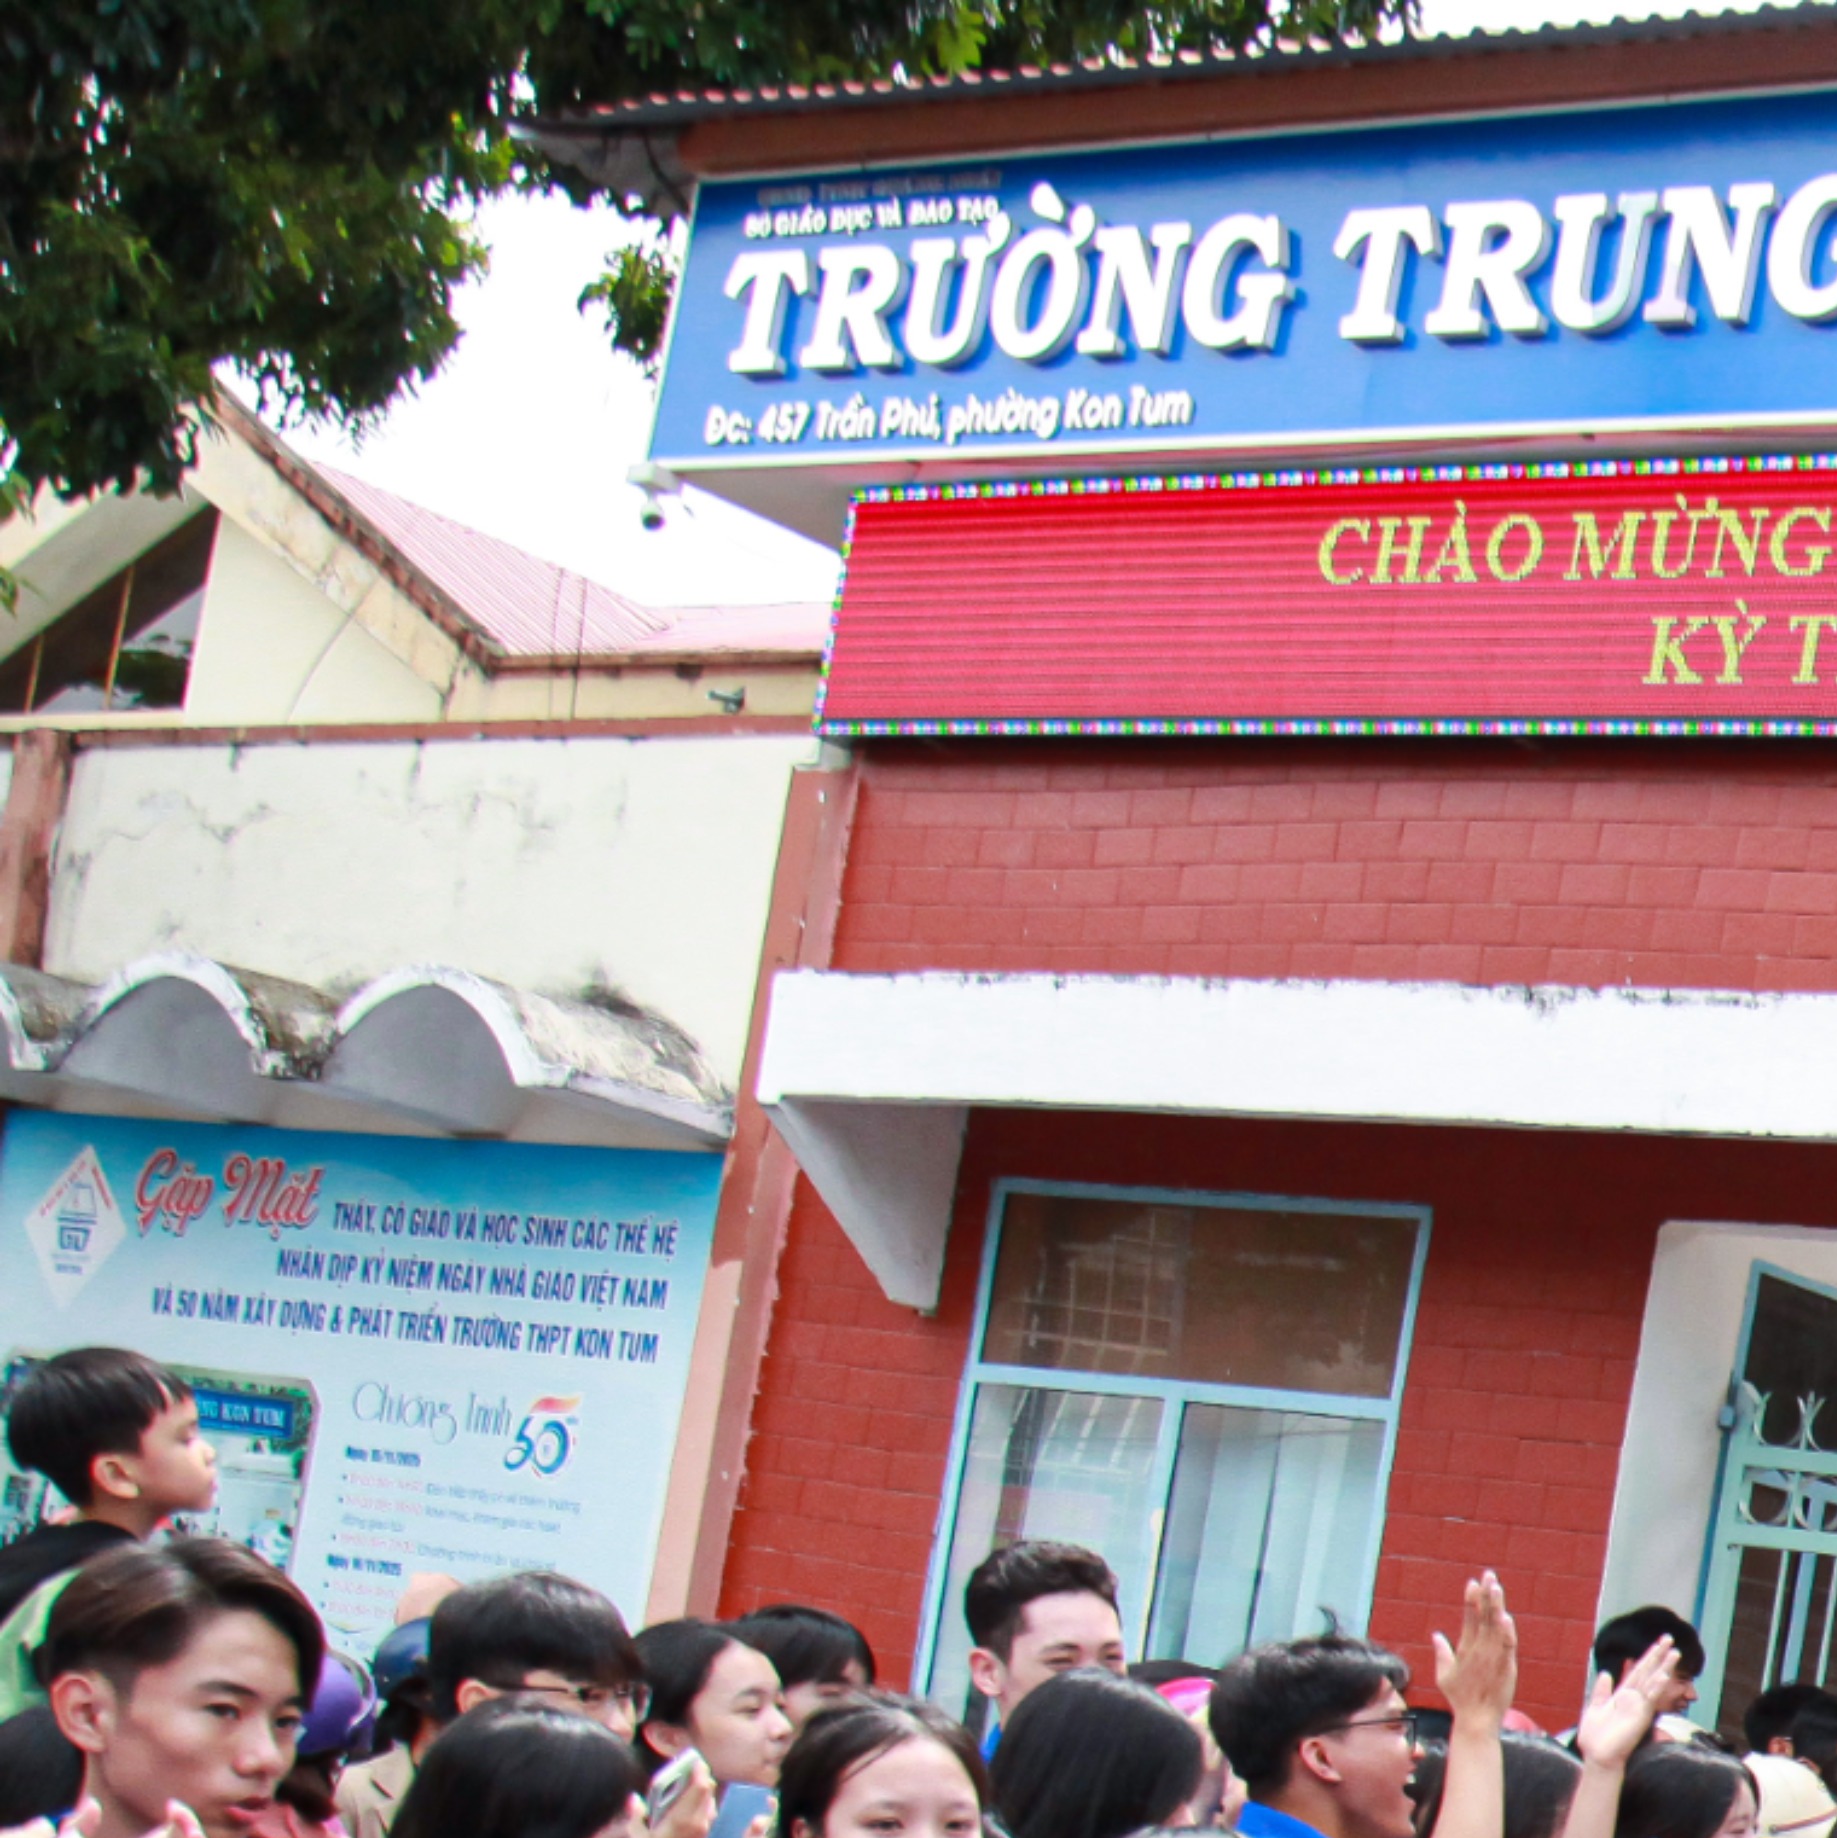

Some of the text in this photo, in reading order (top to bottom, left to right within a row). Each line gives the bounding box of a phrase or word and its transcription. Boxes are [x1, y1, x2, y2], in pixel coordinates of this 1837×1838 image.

[774, 201, 828, 237] GIÁO
[830, 203, 873, 237] DỤC
[876, 195, 903, 229] VÀ
[957, 195, 999, 227] TẠO
[724, 181, 1294, 375] TRƯỜNG
[705, 384, 1194, 446] Đc: 457 Trần Phú, phường Kon Tum
[1316, 500, 1544, 585] CHÀO
[1563, 493, 1832, 581] MỪNG
[1641, 598, 1763, 684] KỲ
[136, 1148, 214, 1237] Gặp
[223, 1154, 325, 1241] Mặt
[455, 1206, 479, 1241] VÀ
[481, 1212, 519, 1250] HỌC
[523, 1215, 570, 1249] SINH
[571, 1213, 609, 1252] CÁC
[614, 1214, 653, 1255] THẾ
[651, 1219, 680, 1263] HỆ
[327, 1253, 359, 1289] DỊP
[387, 1253, 436, 1295] NIỆM
[489, 1261, 529, 1298] NHÀ
[530, 1265, 577, 1302] GIÁO
[581, 1268, 620, 1312] VIỆT
[622, 1277, 669, 1310] NAM
[175, 1289, 199, 1318] 50
[200, 1287, 241, 1324] NĂM
[278, 1300, 327, 1332] DỰNG
[330, 1304, 345, 1335] &
[347, 1302, 393, 1338] PHÁT
[397, 1301, 448, 1344] TRIỂN
[451, 1312, 523, 1351] TRƯỜNG
[526, 1322, 573, 1357] THPT
[574, 1326, 614, 1360] KON
[618, 1330, 660, 1364] TUM
[503, 1415, 570, 1475] 50
